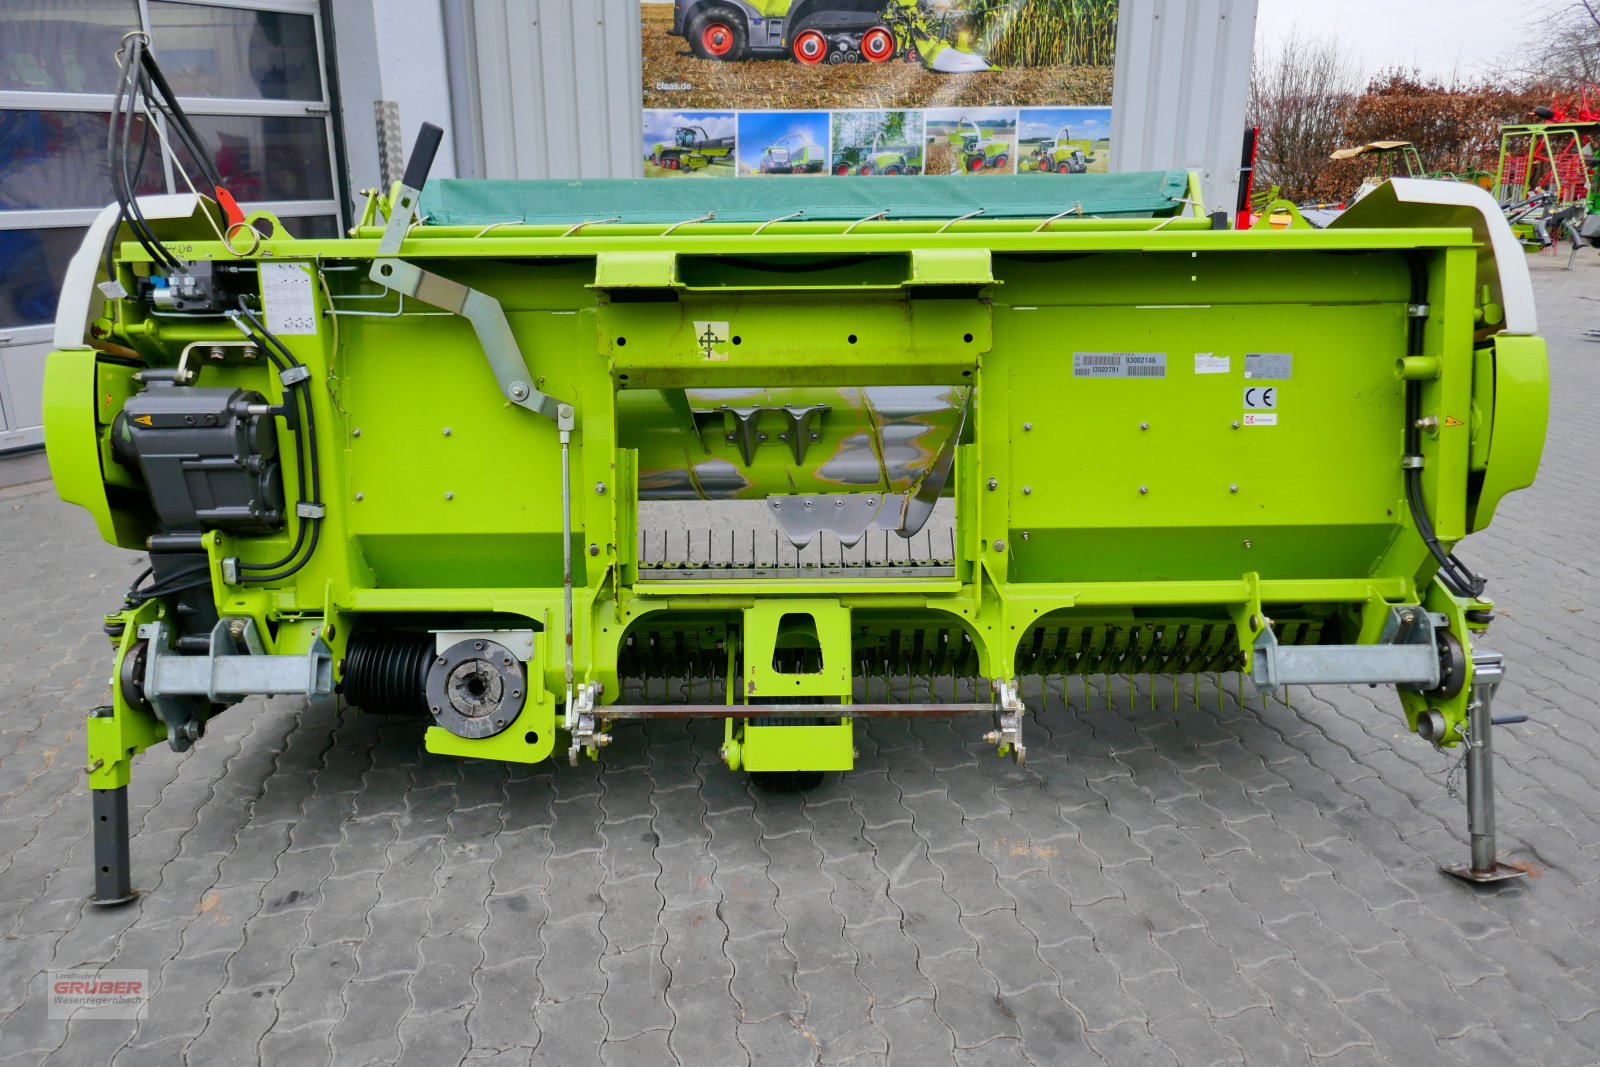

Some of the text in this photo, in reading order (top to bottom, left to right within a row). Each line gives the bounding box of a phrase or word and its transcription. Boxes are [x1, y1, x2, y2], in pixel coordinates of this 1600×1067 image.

[656, 81, 692, 91] claas.de
[1125, 356, 1157, 364] 93002146
[1245, 387, 1273, 407] CE
